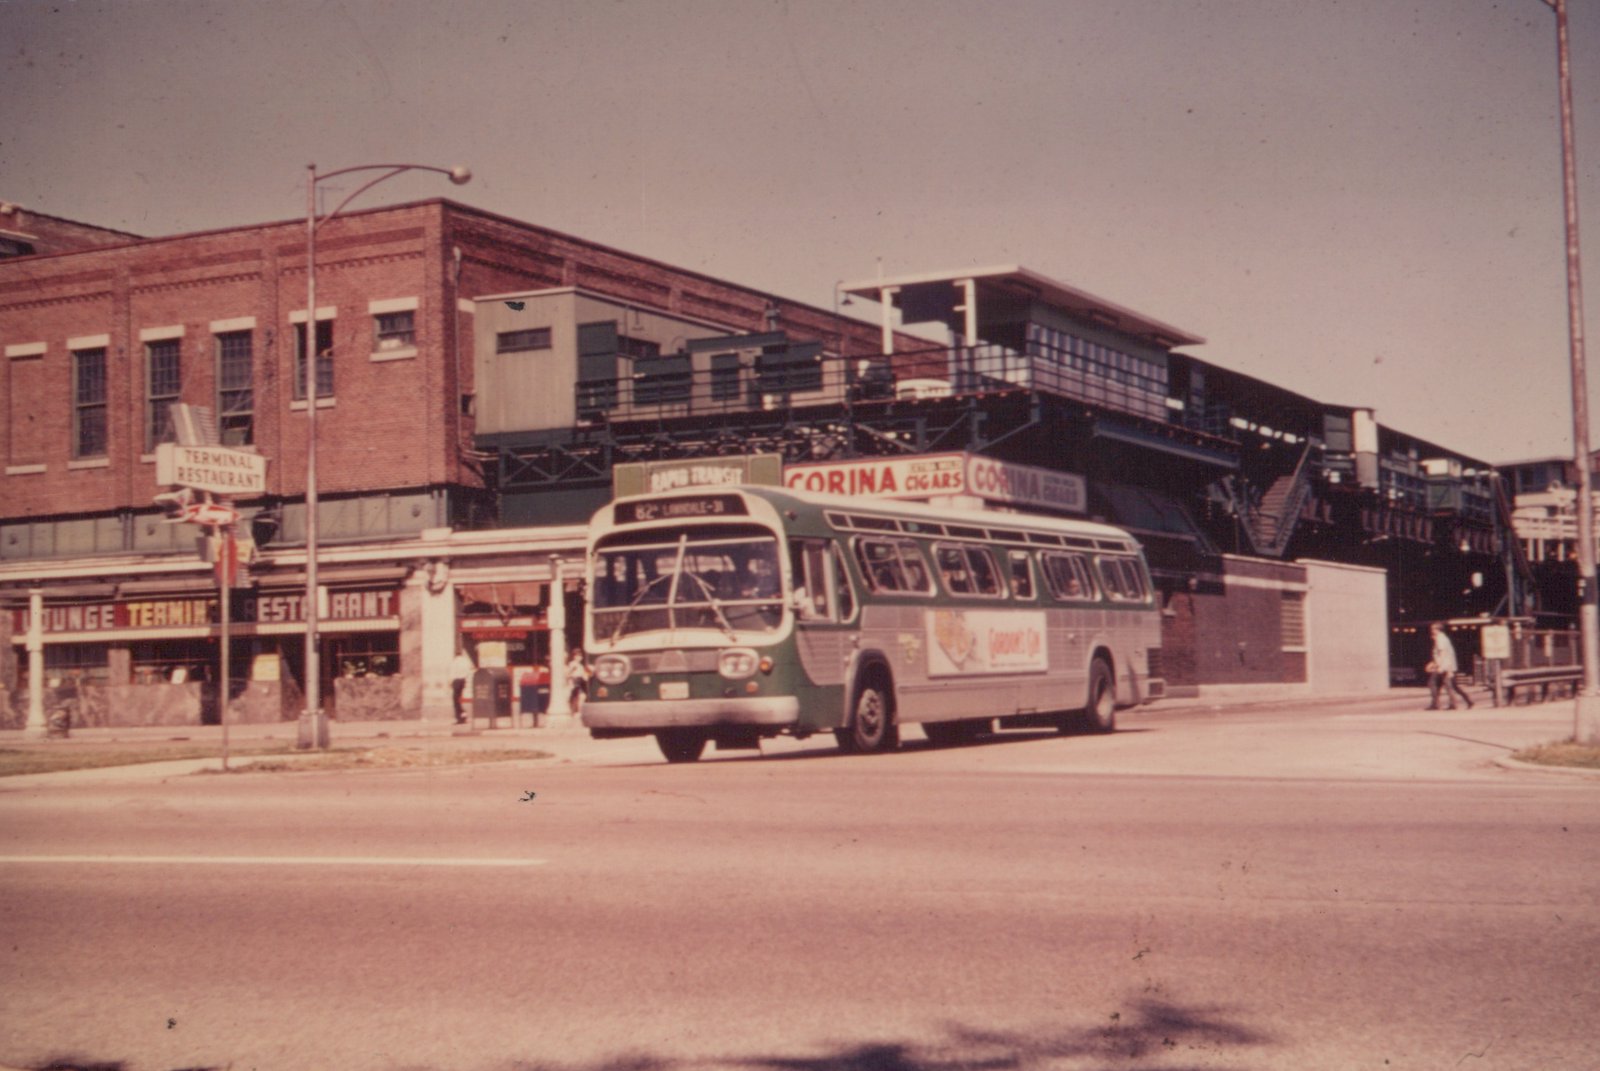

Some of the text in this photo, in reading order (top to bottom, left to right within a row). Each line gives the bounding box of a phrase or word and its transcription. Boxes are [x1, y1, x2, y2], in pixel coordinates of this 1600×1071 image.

[184, 449, 254, 470] TERMINAL
[177, 467, 261, 488] RESTAURANT
[691, 465, 743, 487] TRANSIT
[788, 466, 898, 496] CORINA
[905, 471, 962, 491] CIGARS
[975, 463, 1041, 499] CORINA
